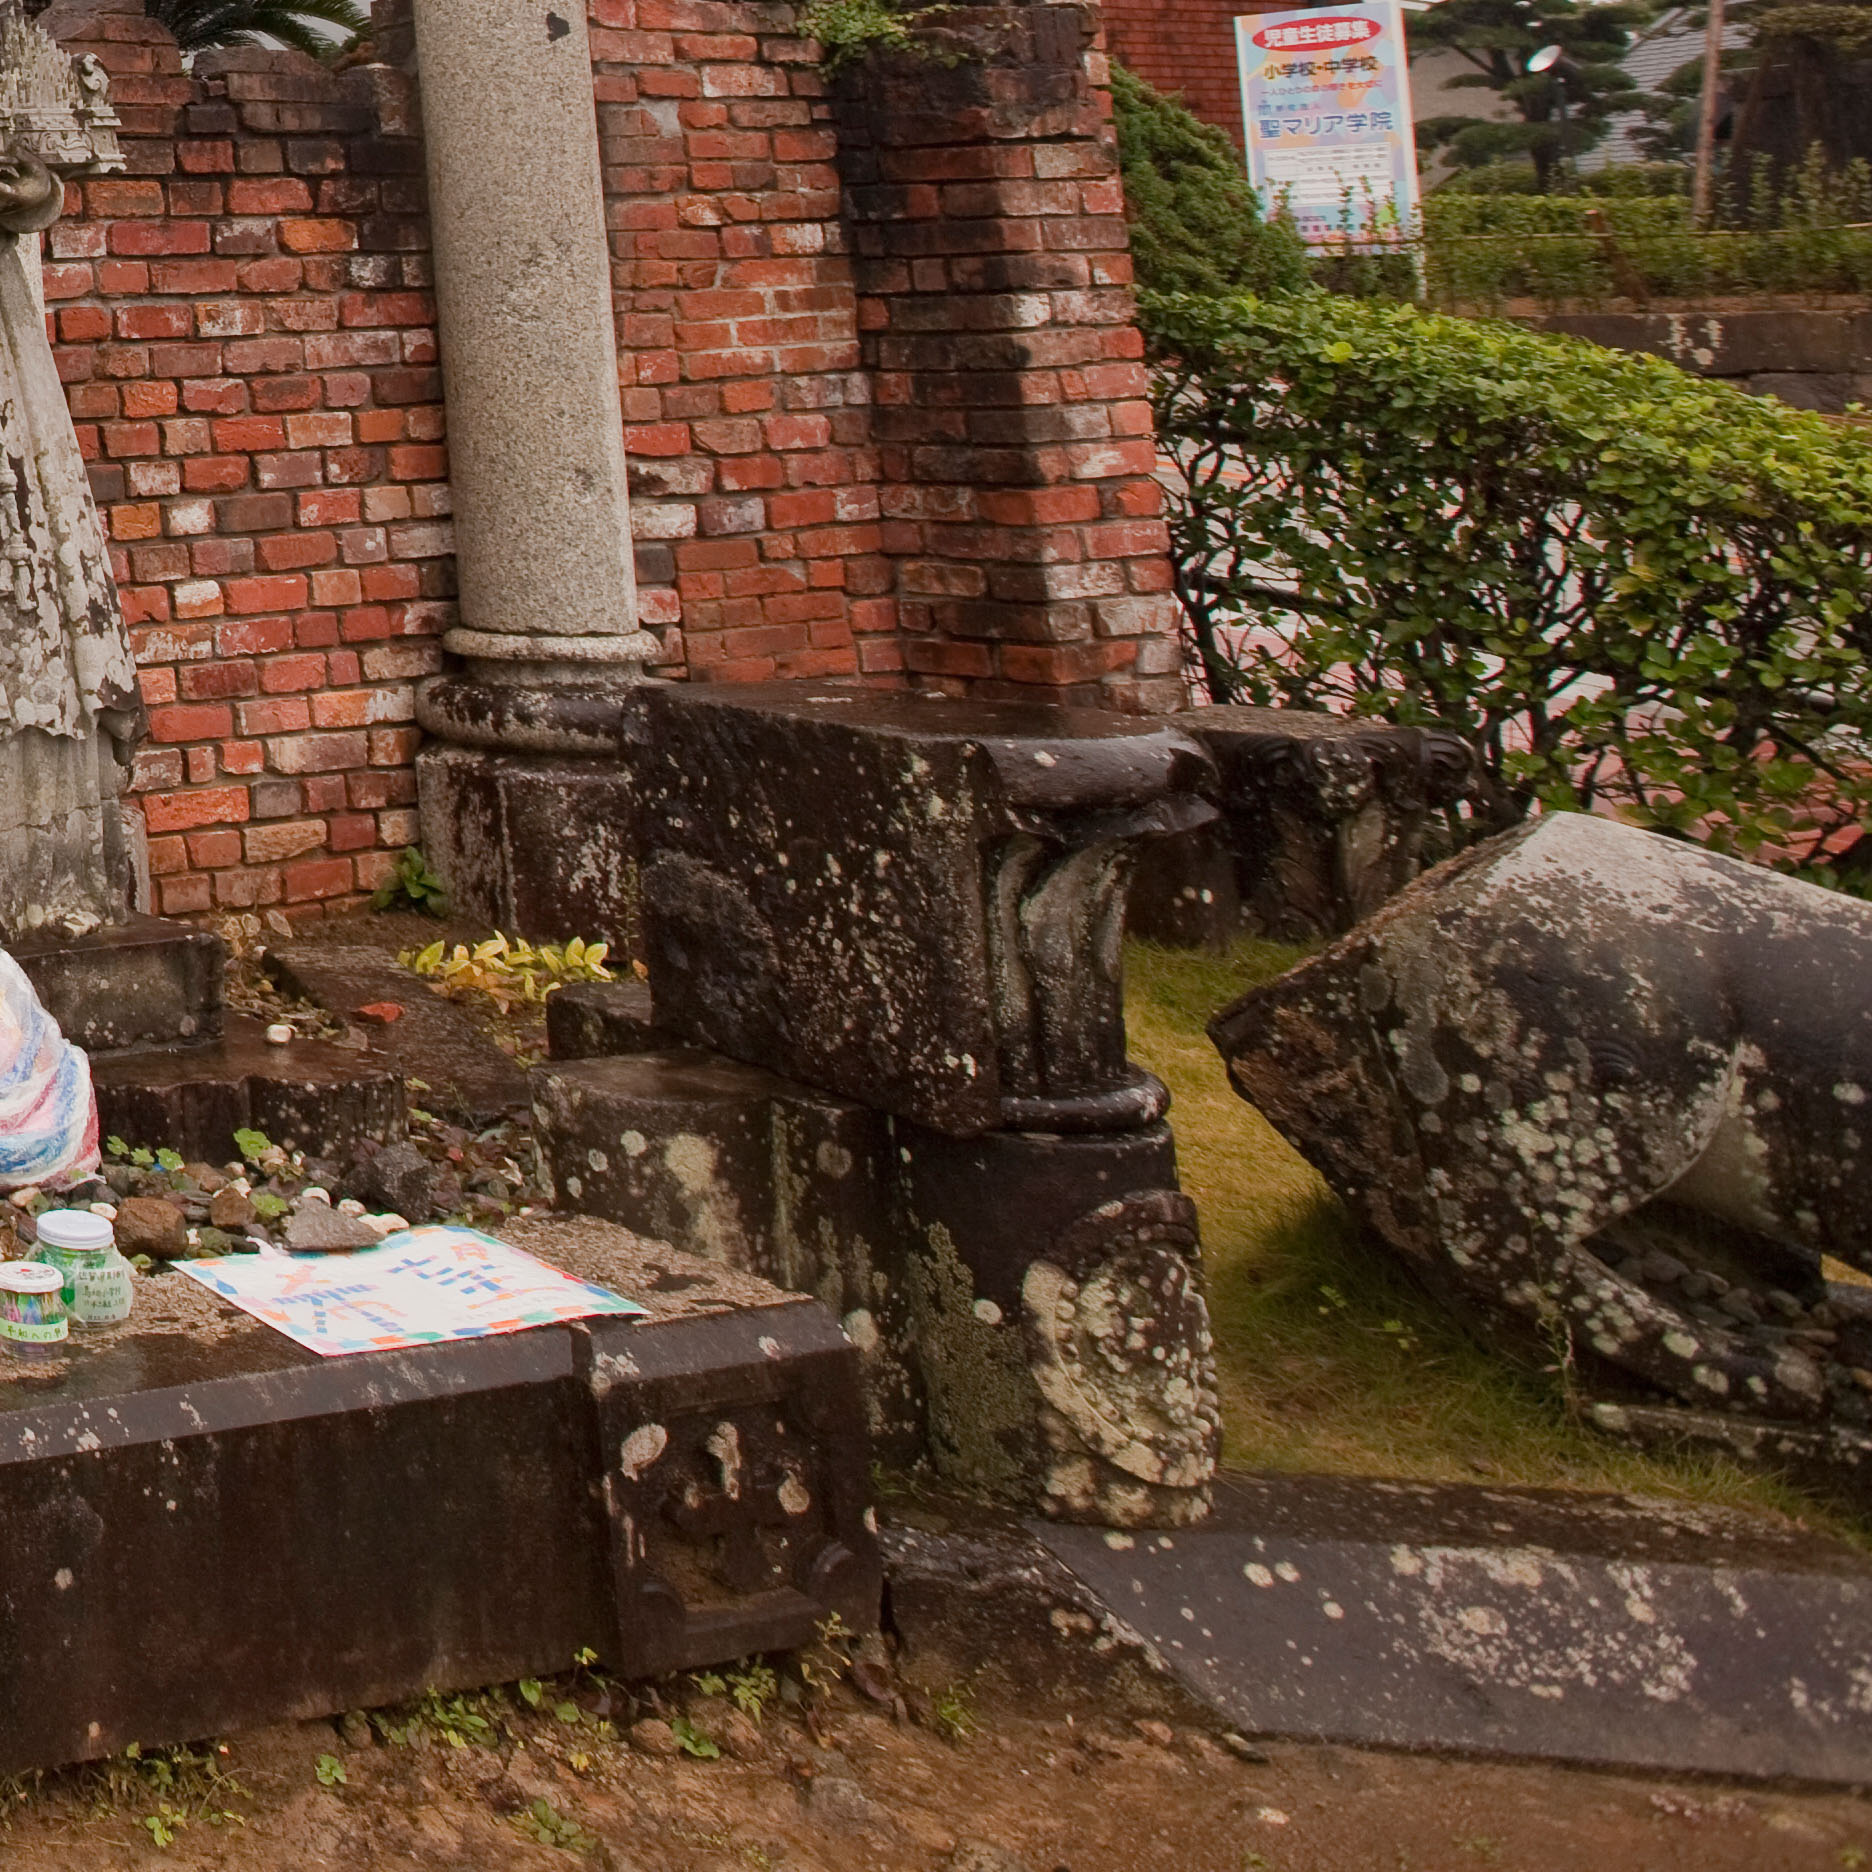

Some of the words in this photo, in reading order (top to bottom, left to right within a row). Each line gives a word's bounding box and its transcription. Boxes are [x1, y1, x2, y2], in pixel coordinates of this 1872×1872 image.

[1263, 20, 1371, 48] 児童生徒募集
[1259, 112, 1393, 138] 聖マリア学院
